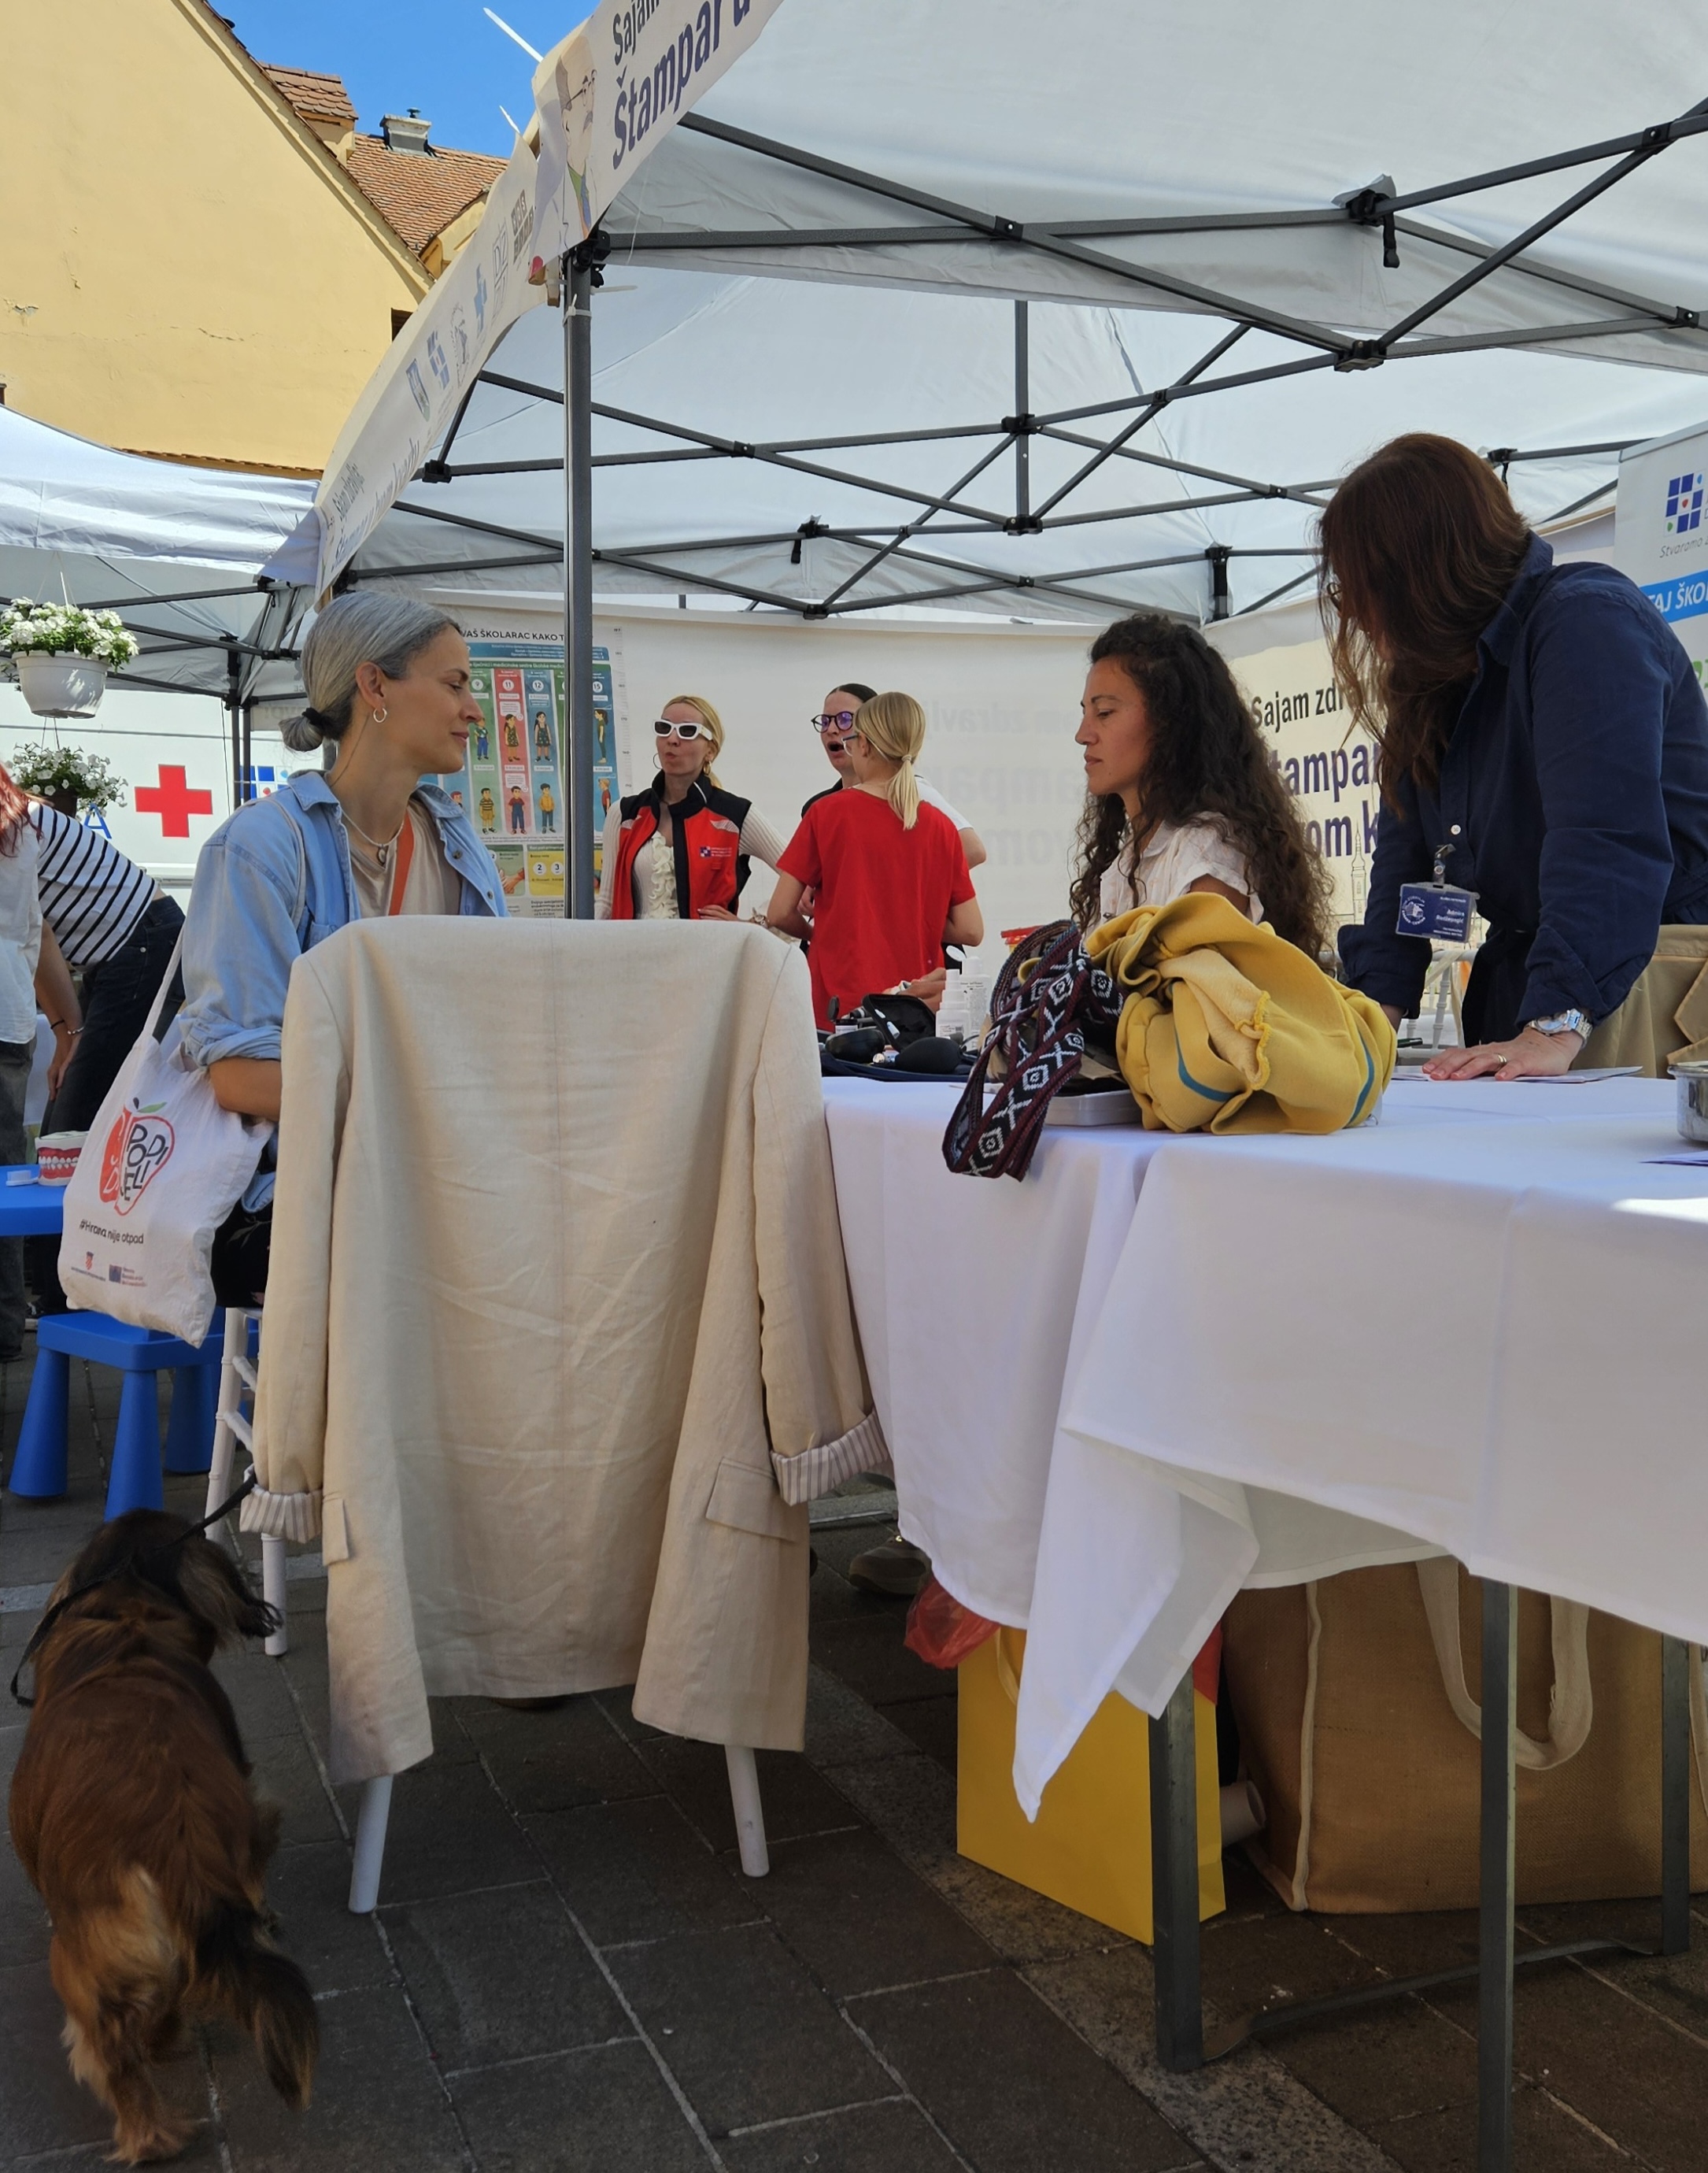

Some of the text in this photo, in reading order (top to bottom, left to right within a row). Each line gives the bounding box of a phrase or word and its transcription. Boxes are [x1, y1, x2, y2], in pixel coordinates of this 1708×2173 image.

[1659, 538, 1702, 558] Stvaramo
[480, 628, 530, 639] ŠKOLARAC
[532, 632, 557, 641] KAKO
[1251, 691, 1309, 733] Sajam
[79, 1219, 144, 1245] #Hrana nije otpad
